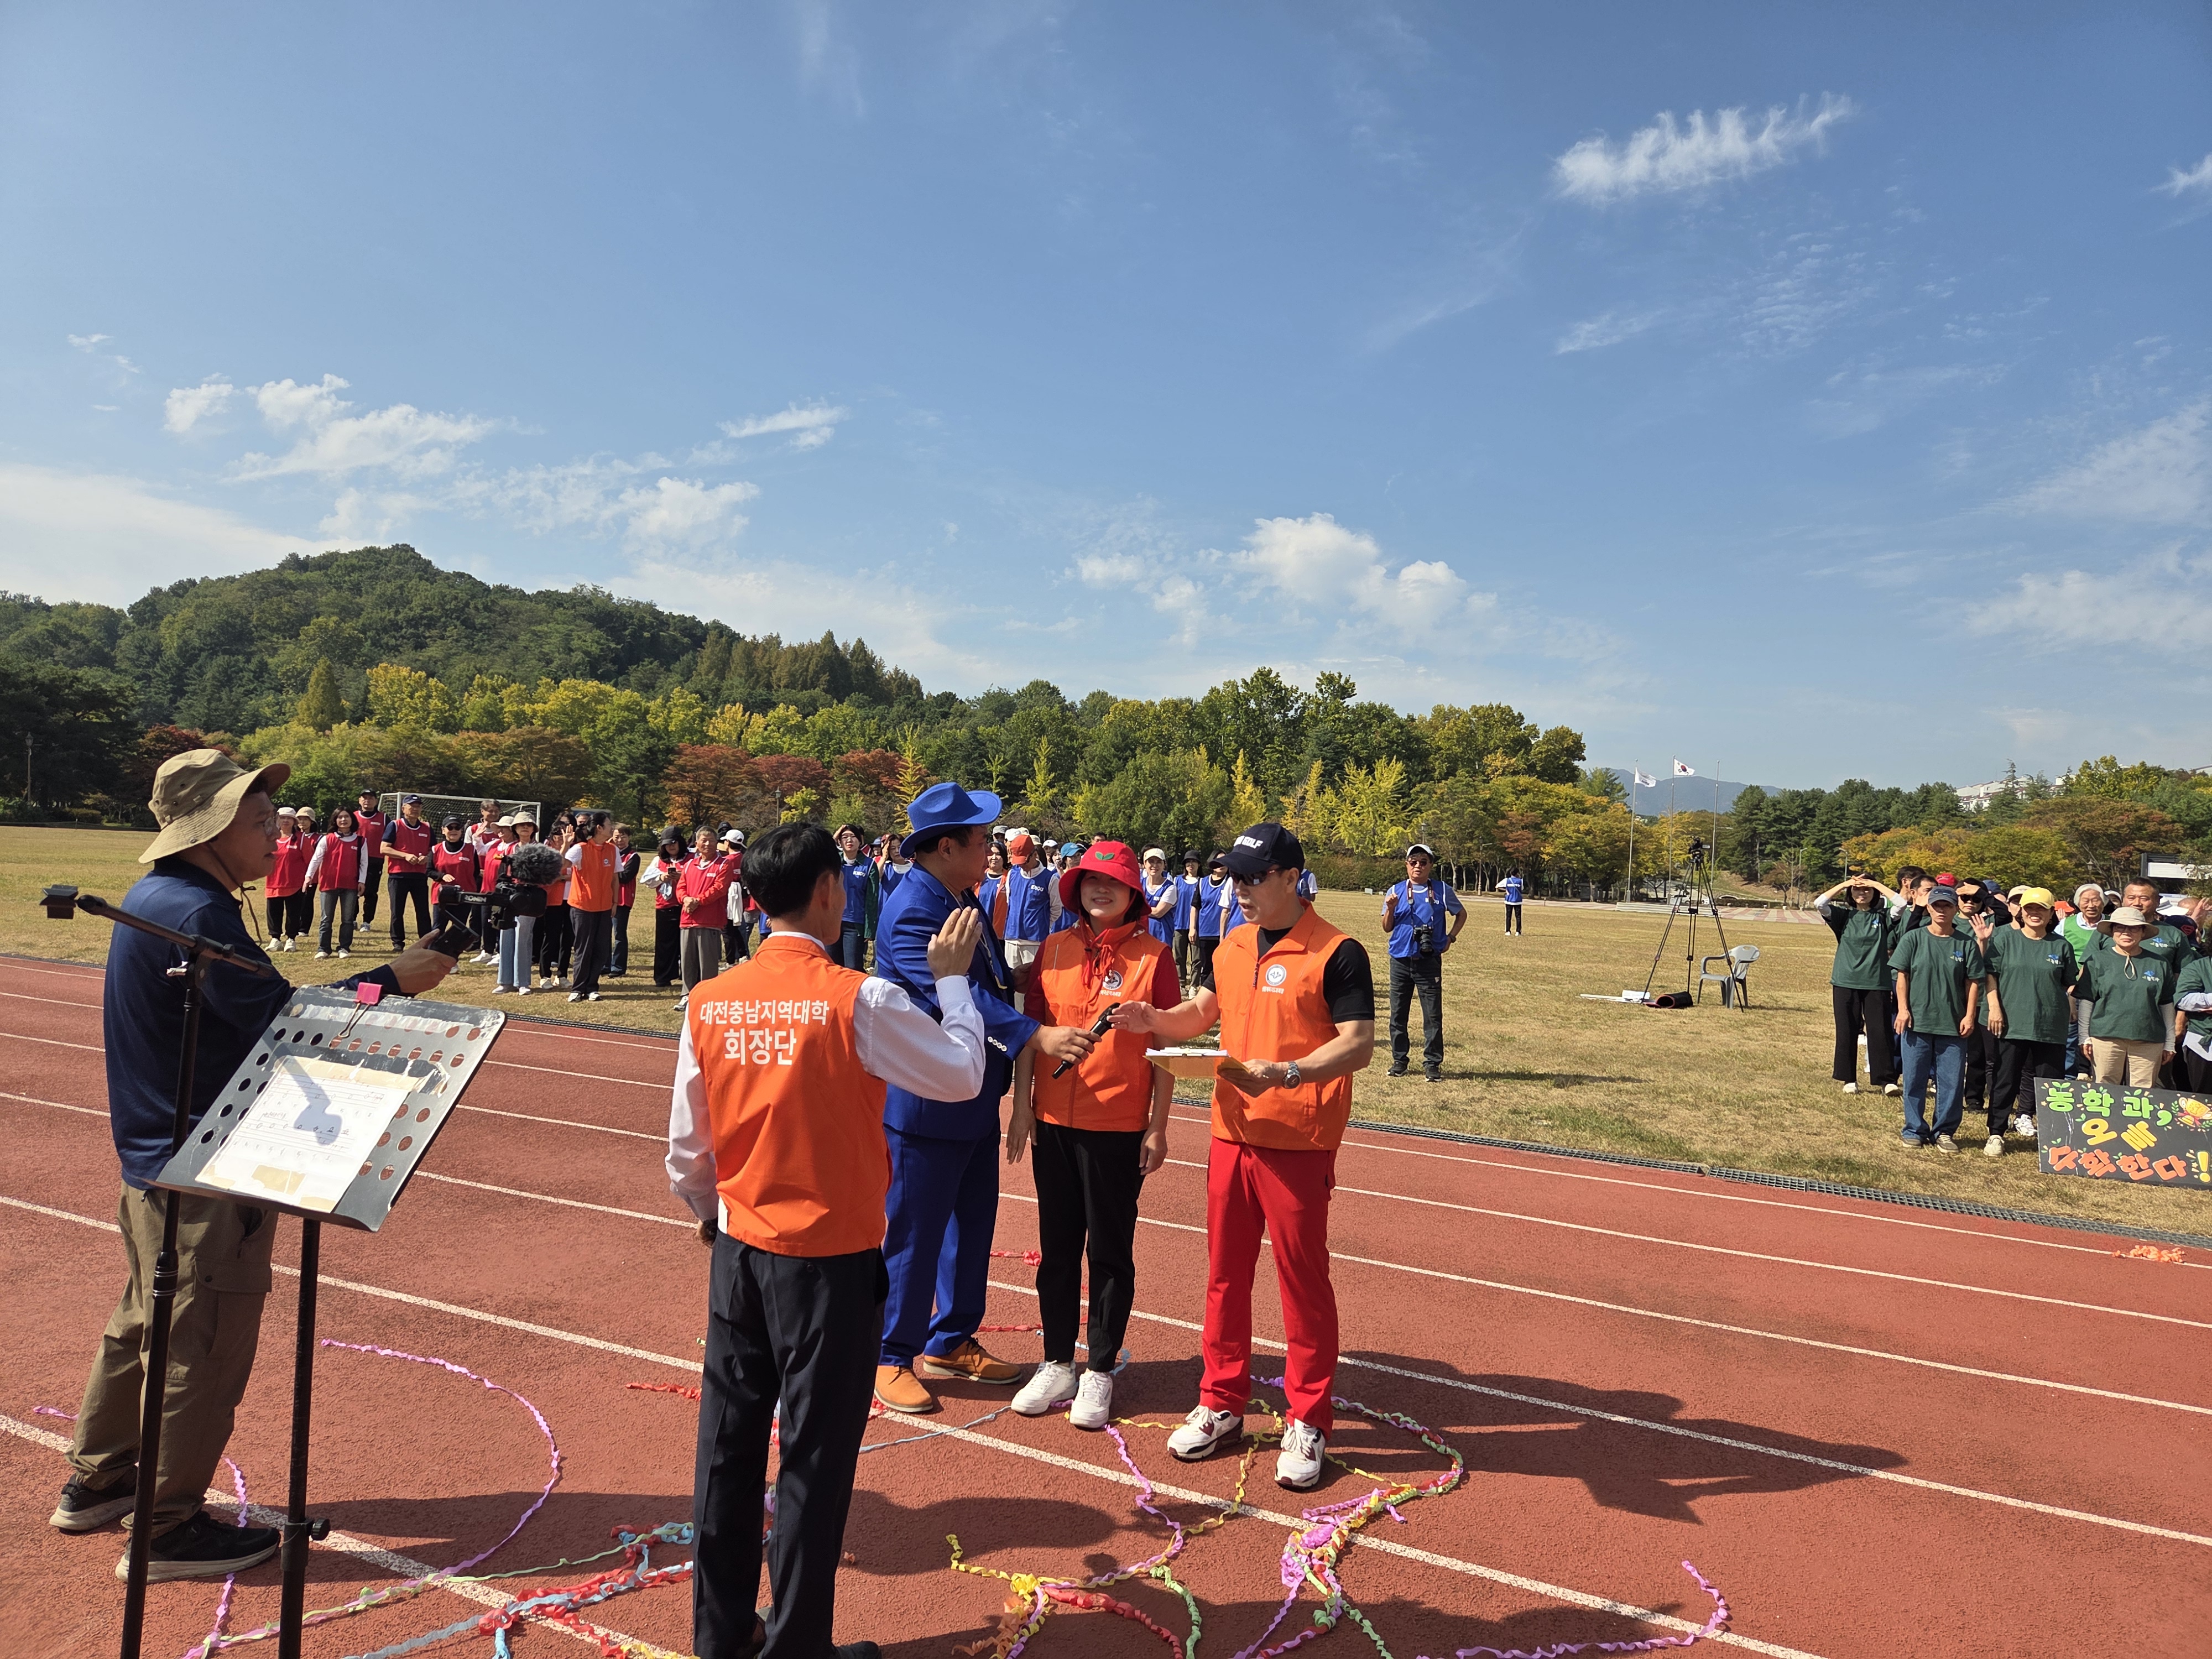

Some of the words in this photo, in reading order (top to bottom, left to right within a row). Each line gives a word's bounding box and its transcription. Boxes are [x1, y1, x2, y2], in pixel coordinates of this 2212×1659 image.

[1241, 836, 1264, 849] GOLF
[700, 1000, 830, 1025] 대전충남지역대학
[724, 1027, 797, 1066] 회장단
[2046, 1088, 2173, 1126] 농학과,
[2081, 1118, 2157, 1152] 오늘
[2048, 1145, 2211, 1183] 수확한다!
